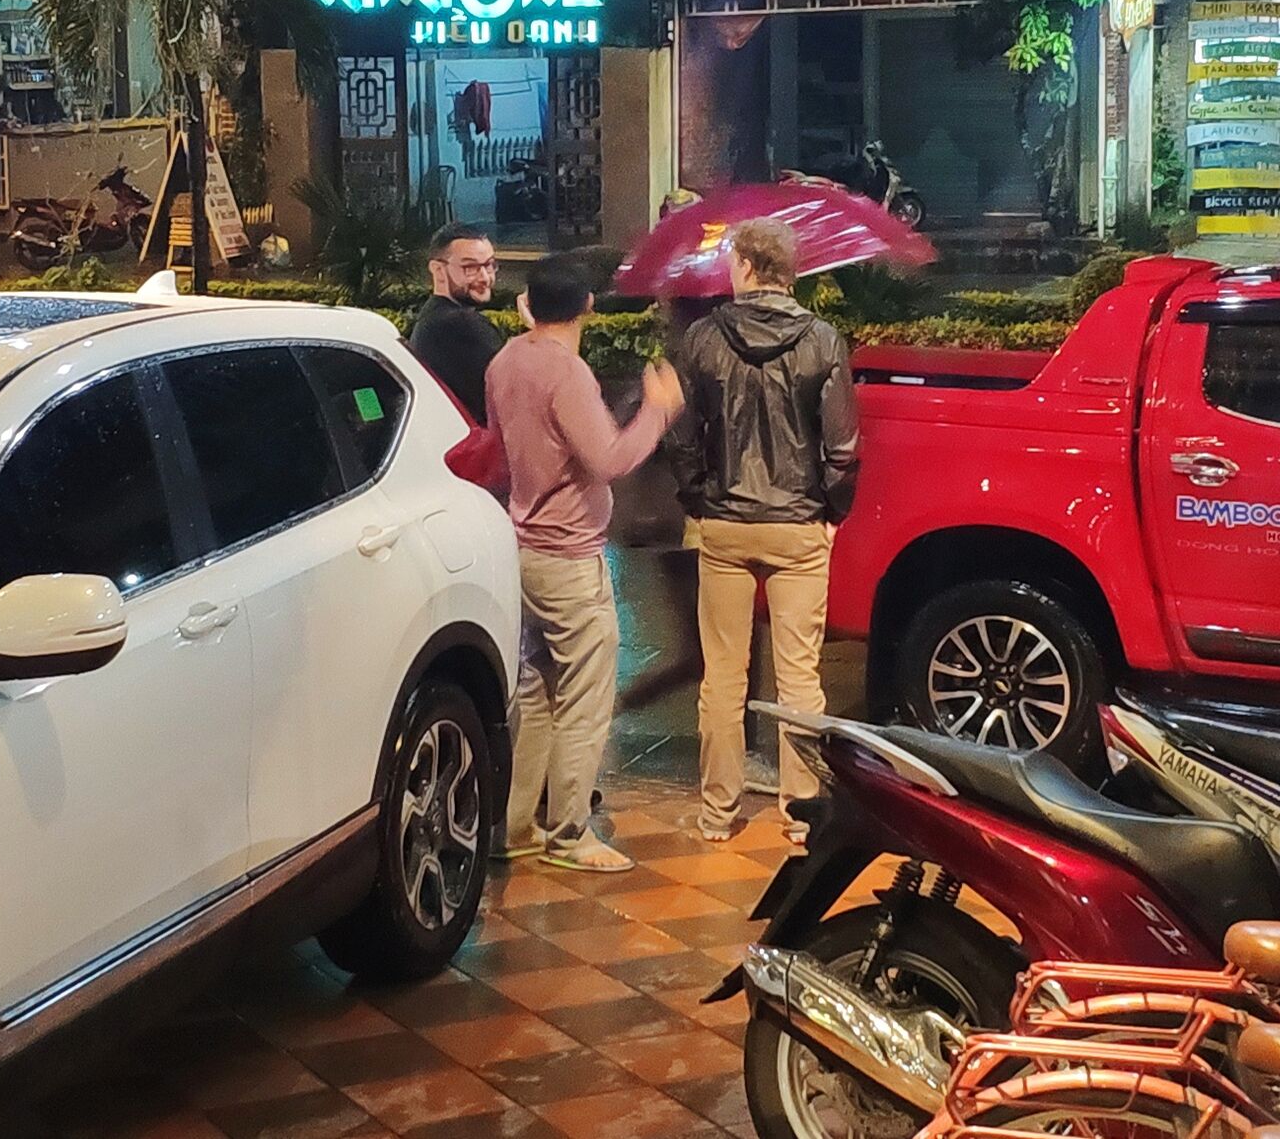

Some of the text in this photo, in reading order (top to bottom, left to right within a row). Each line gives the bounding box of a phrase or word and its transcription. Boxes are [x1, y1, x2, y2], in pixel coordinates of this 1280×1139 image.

[1202, 2, 1280, 15] MINI MART
[507, 19, 598, 44] OANH
[1203, 65, 1227, 75] TAXI
[1203, 127, 1258, 138] LAUNDRY
[1159, 744, 1219, 796] YAMAHA
